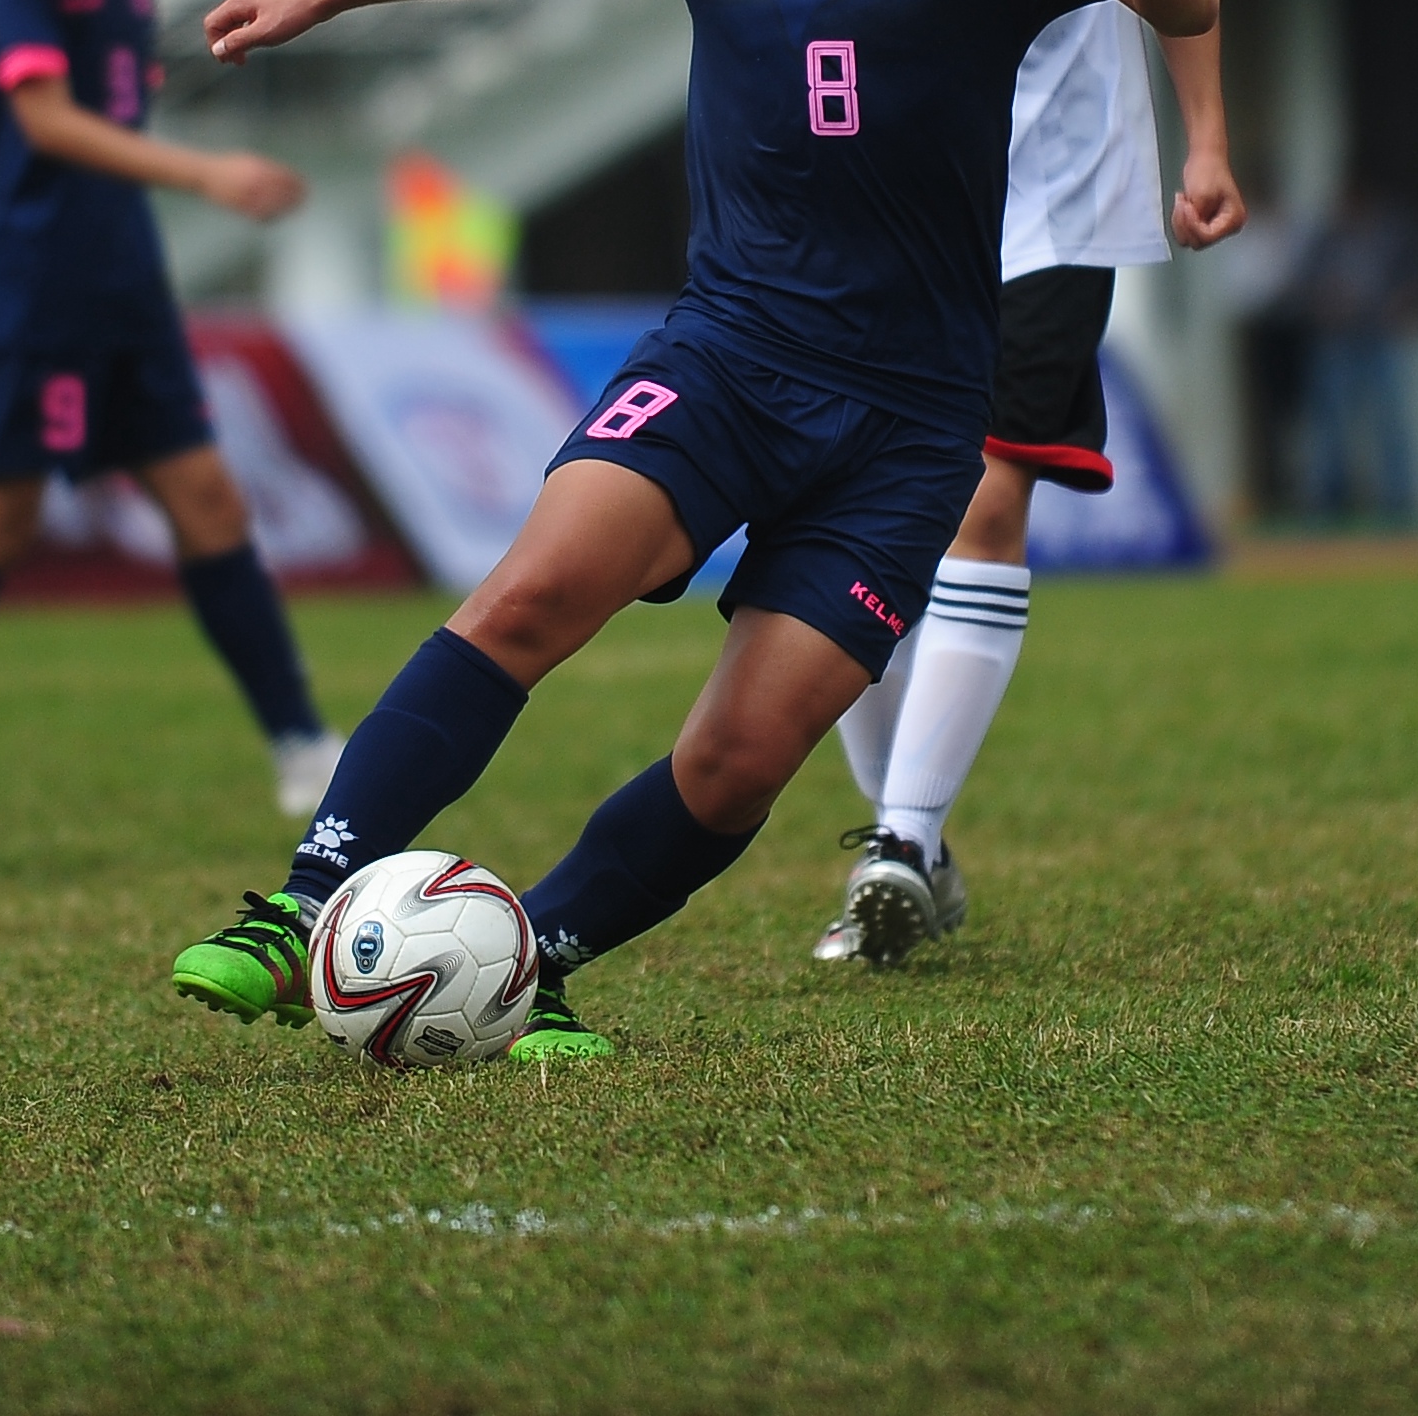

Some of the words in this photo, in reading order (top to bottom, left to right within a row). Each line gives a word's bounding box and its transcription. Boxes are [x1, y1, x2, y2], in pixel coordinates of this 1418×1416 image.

[806, 40, 860, 136] 8
[40, 374, 87, 451] 9
[586, 380, 679, 439] 8
